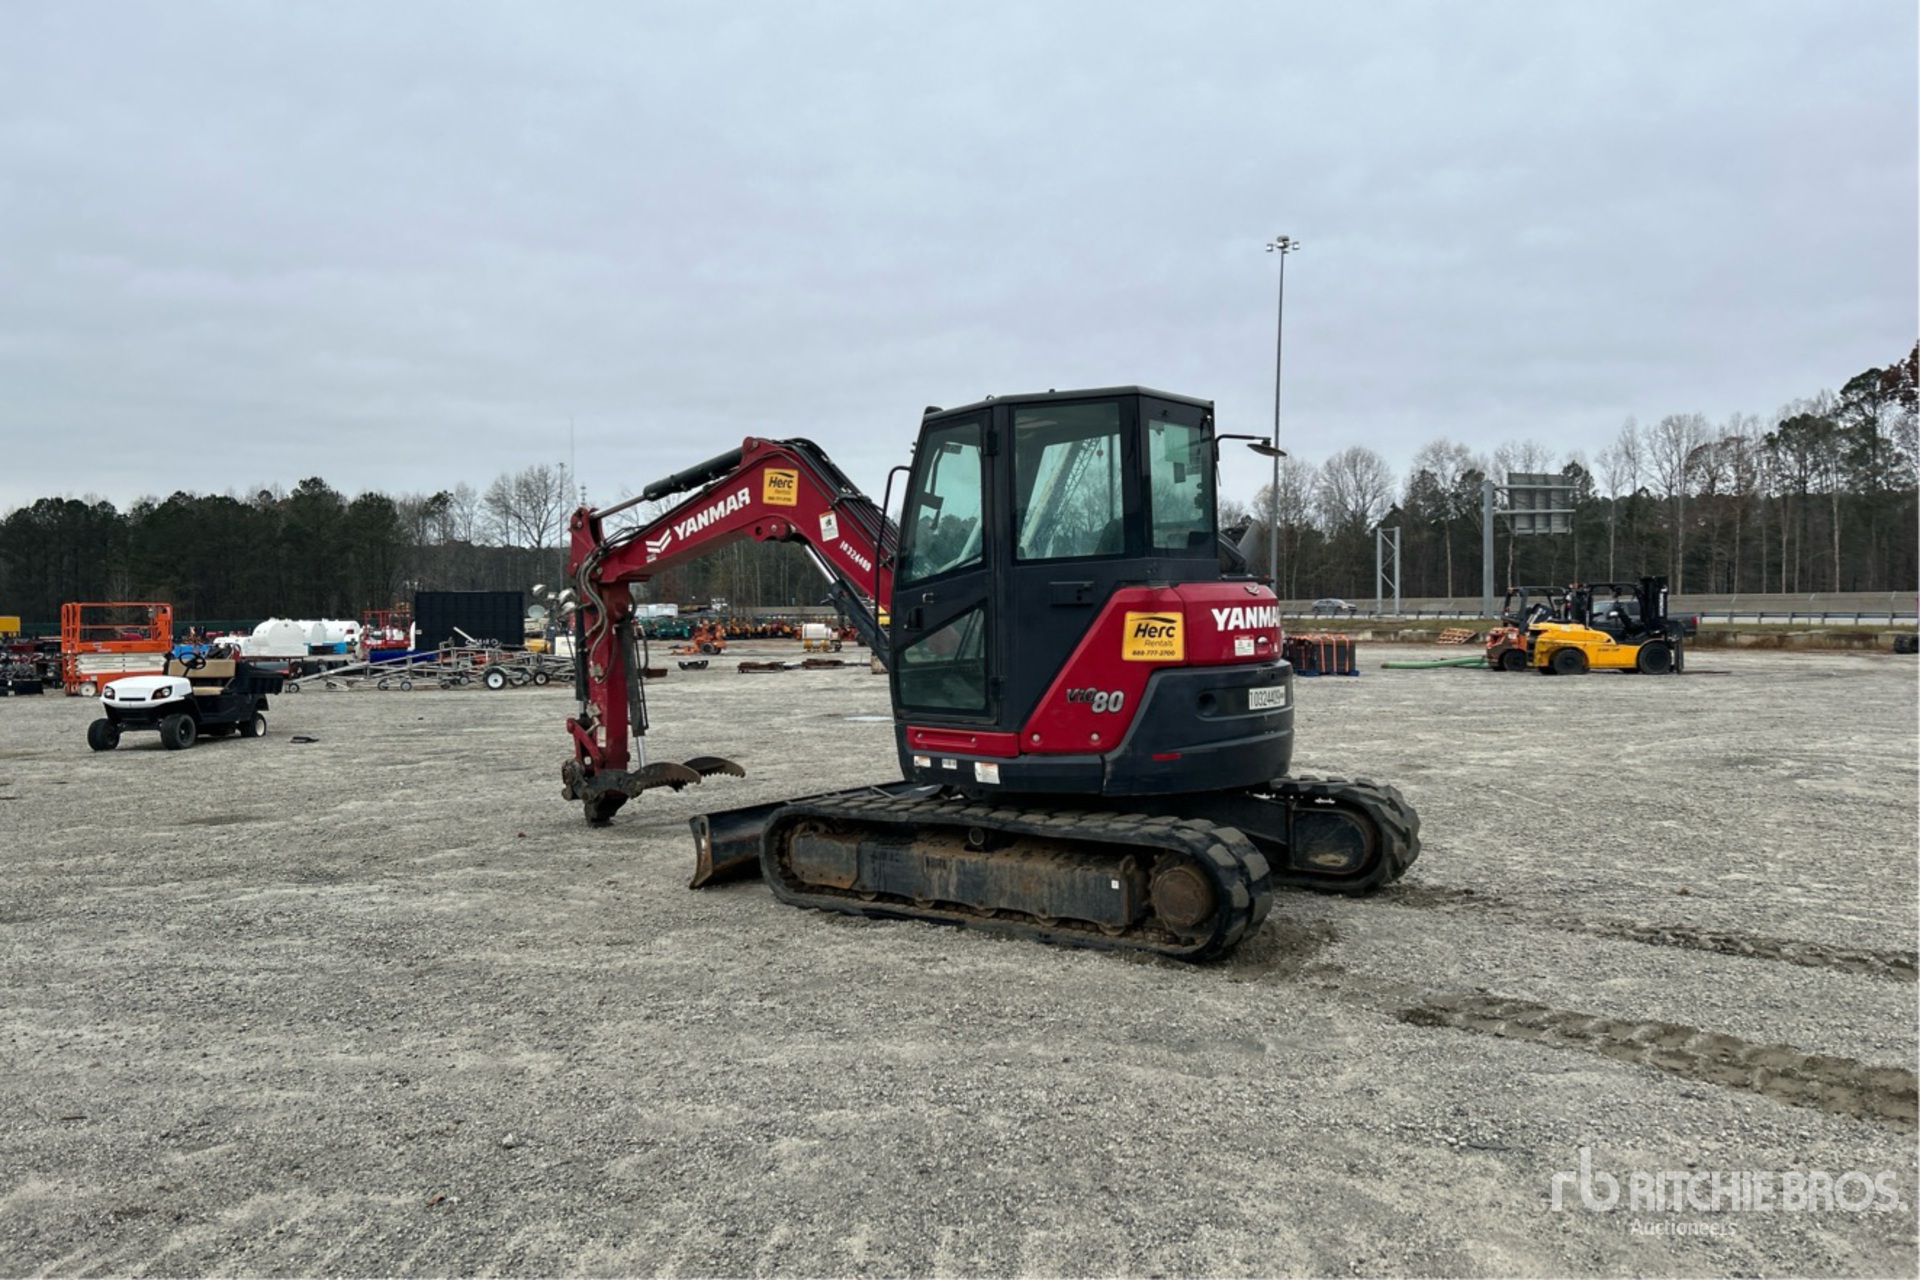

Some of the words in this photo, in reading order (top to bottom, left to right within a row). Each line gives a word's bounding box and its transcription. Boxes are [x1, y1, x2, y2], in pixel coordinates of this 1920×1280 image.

[769, 476, 794, 489] Herc
[673, 487, 751, 541] YANMAR
[1210, 606, 1281, 632] YANMA
[1133, 623, 1176, 638] Herc
[1144, 639, 1174, 647] Rentals
